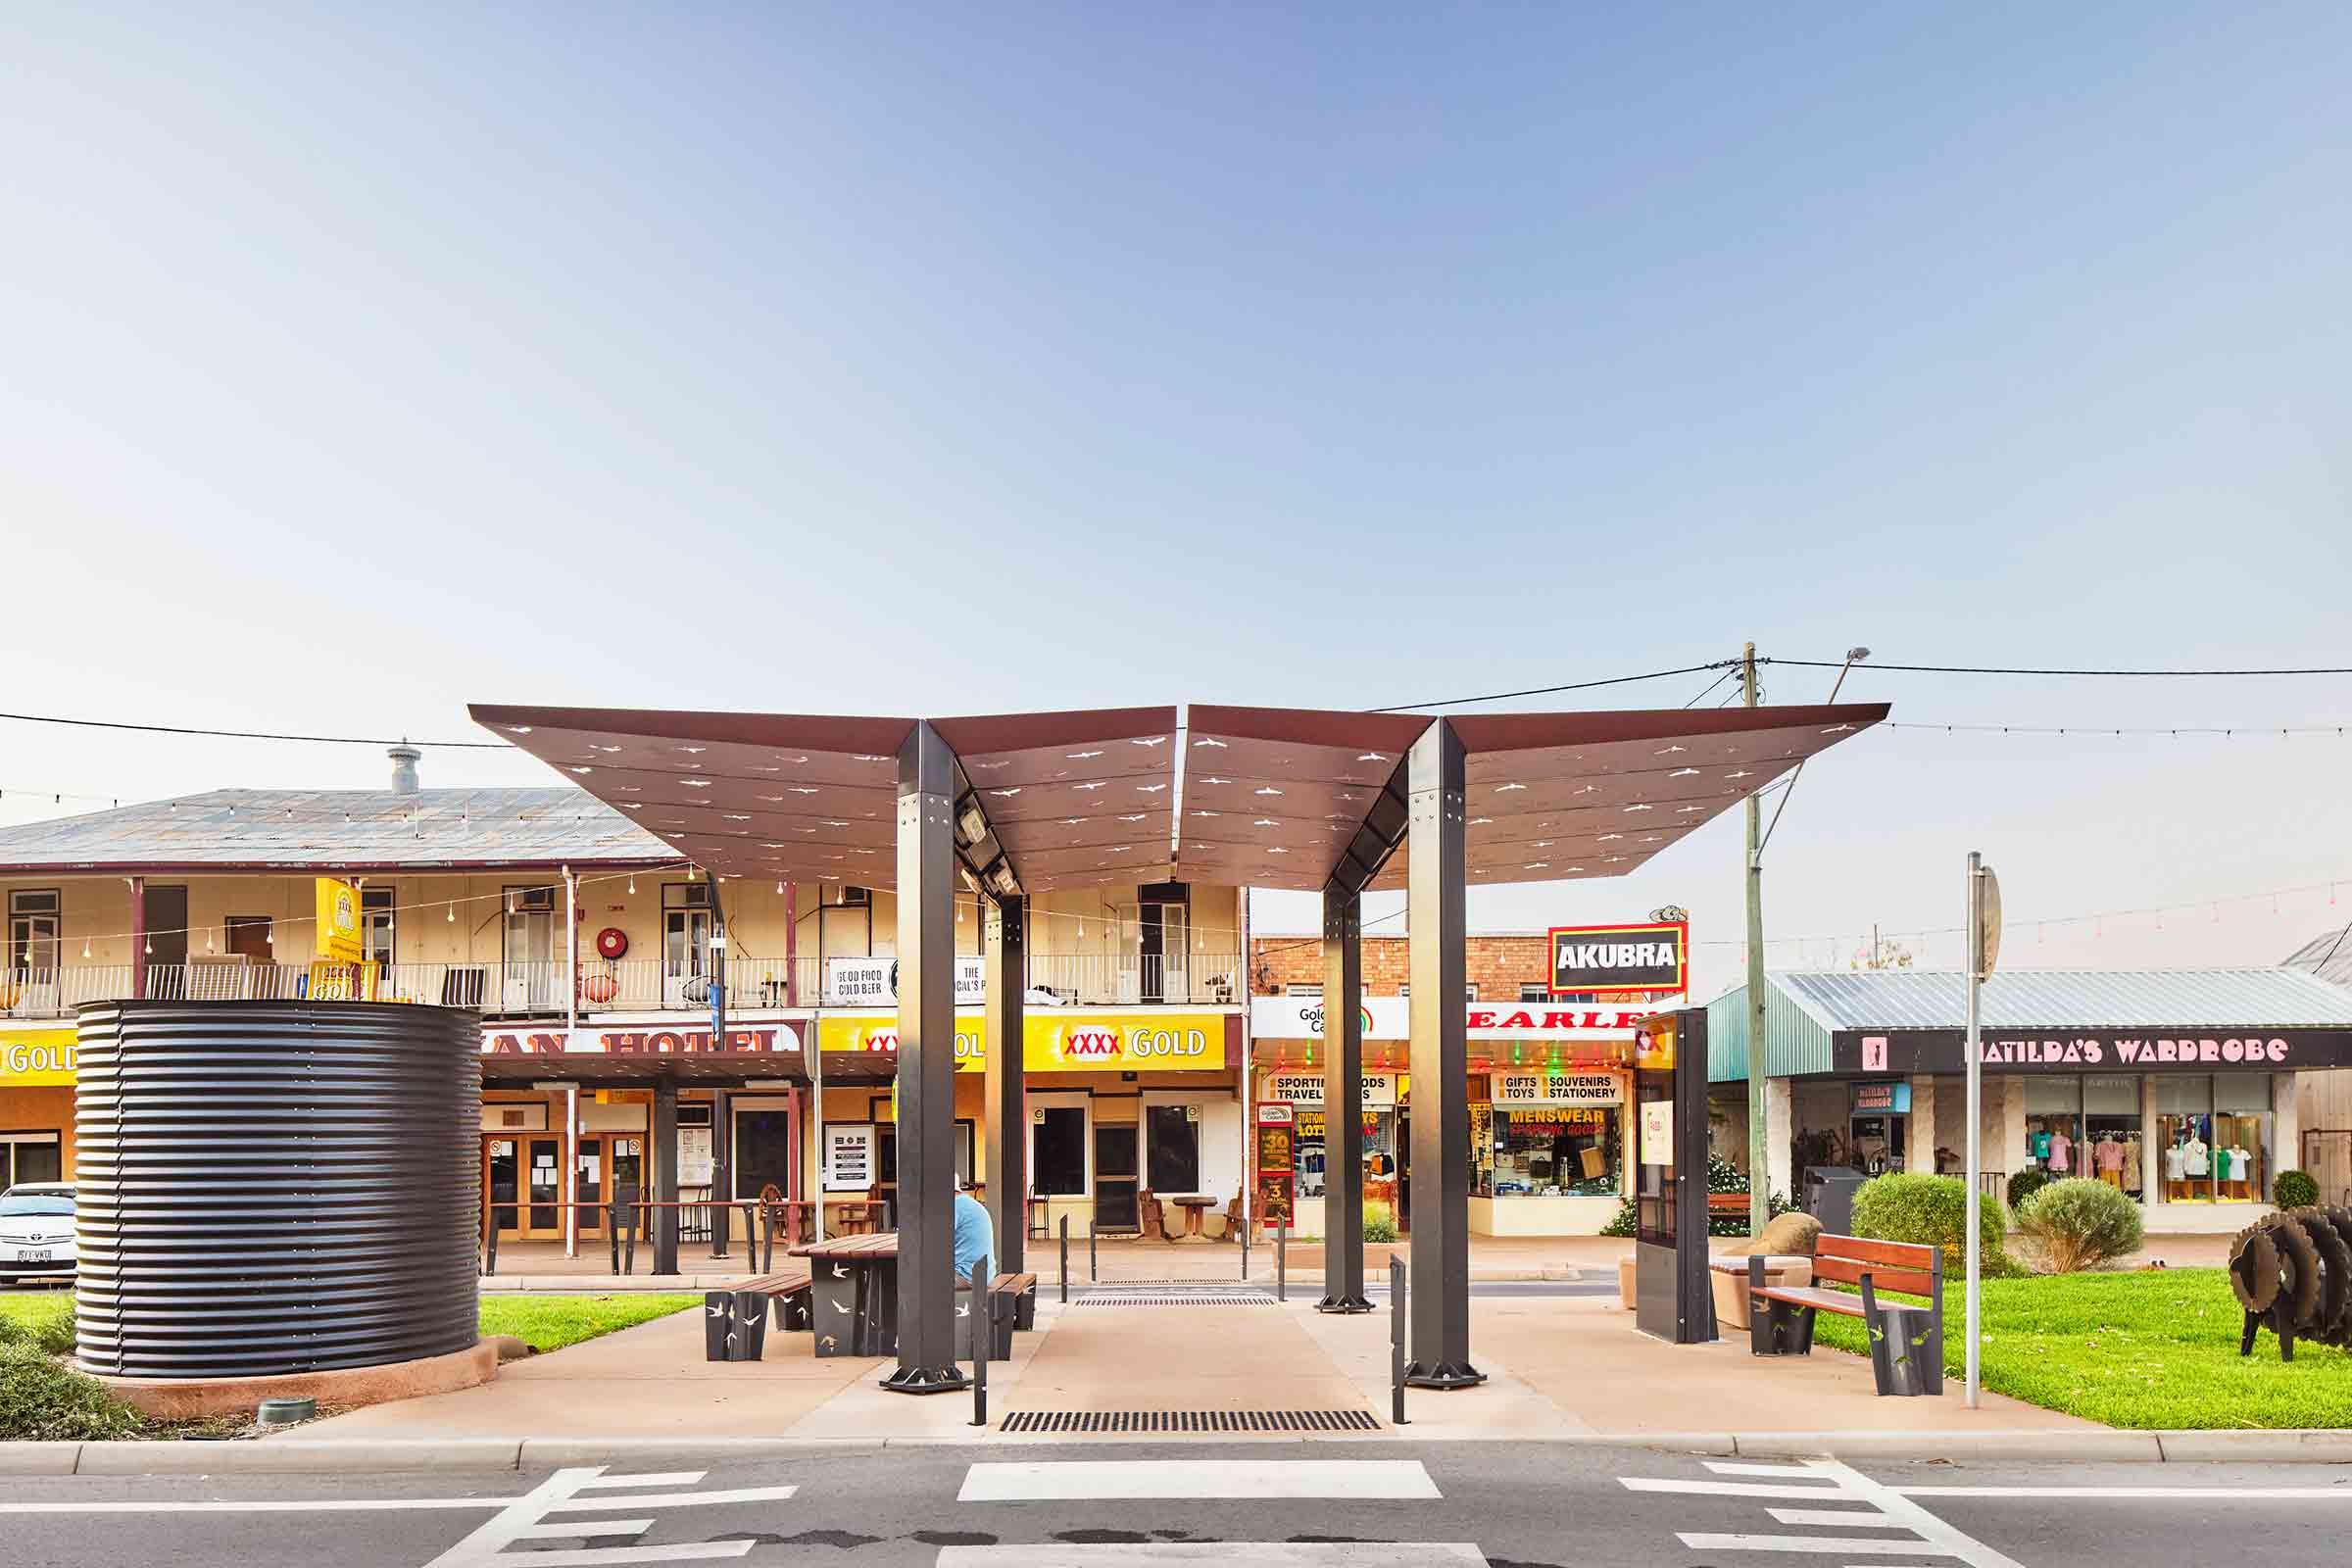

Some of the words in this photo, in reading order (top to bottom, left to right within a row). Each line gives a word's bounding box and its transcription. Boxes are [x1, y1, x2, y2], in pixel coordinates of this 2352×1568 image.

[1557, 942, 1675, 969] AKUBRA
[837, 971, 858, 982] GOOD
[861, 969, 882, 981] FOOD
[964, 967, 979, 979] THE
[839, 983, 859, 996] COLD
[861, 982, 882, 994] BEER
[956, 980, 979, 992] CAL'S
[1465, 1011, 1659, 1029] EARLE
[480, 1035, 567, 1053] AN
[955, 1033, 987, 1057] OL
[1064, 1033, 1122, 1054] XXXX
[1132, 1029, 1206, 1057] GOLD
[1965, 1039, 2103, 1063] ATILDA'S
[2115, 1039, 2289, 1063] WARDROBE
[8, 1045, 78, 1073] GOLD
[1277, 1078, 1324, 1088] SPORTI
[1362, 1078, 1385, 1088] ODS
[1505, 1077, 1537, 1088] GIFTS
[1549, 1077, 1611, 1087] SOUVENIRS
[1277, 1090, 1323, 1100] TRAVEL
[1505, 1088, 1535, 1099] TOYS
[1549, 1088, 1616, 1099] STATIONERY
[1510, 1110, 1604, 1123] MENSWEAR
